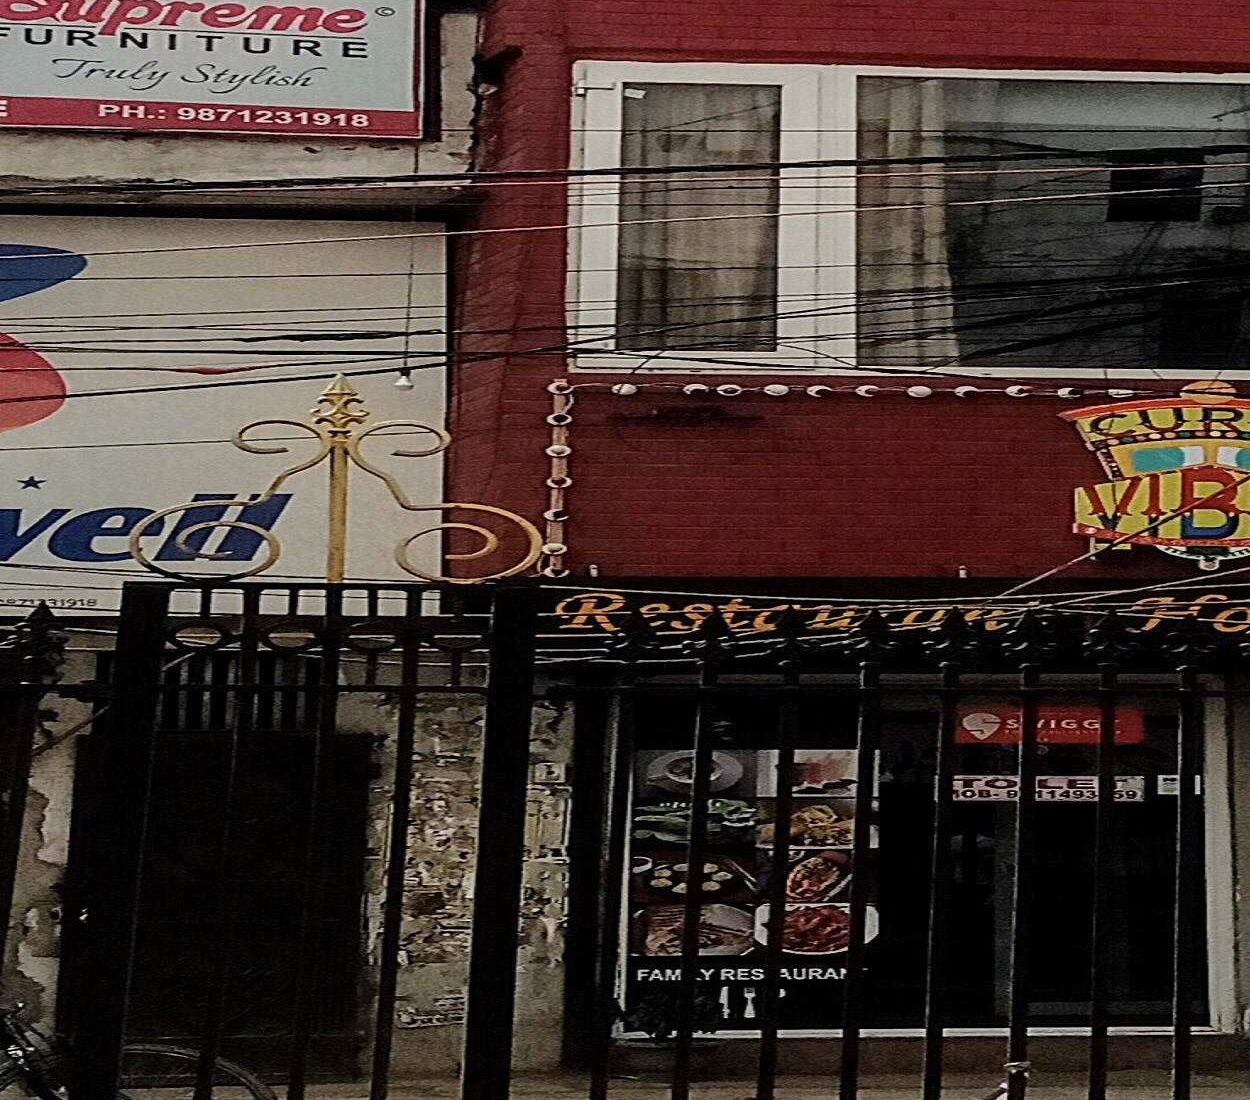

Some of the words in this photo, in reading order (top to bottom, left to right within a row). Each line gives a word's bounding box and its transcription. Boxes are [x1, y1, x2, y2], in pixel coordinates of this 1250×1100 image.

[51, 58, 170, 90] Truly
[180, 63, 328, 94] Stylish
[177, 106, 370, 128] 9871231918
